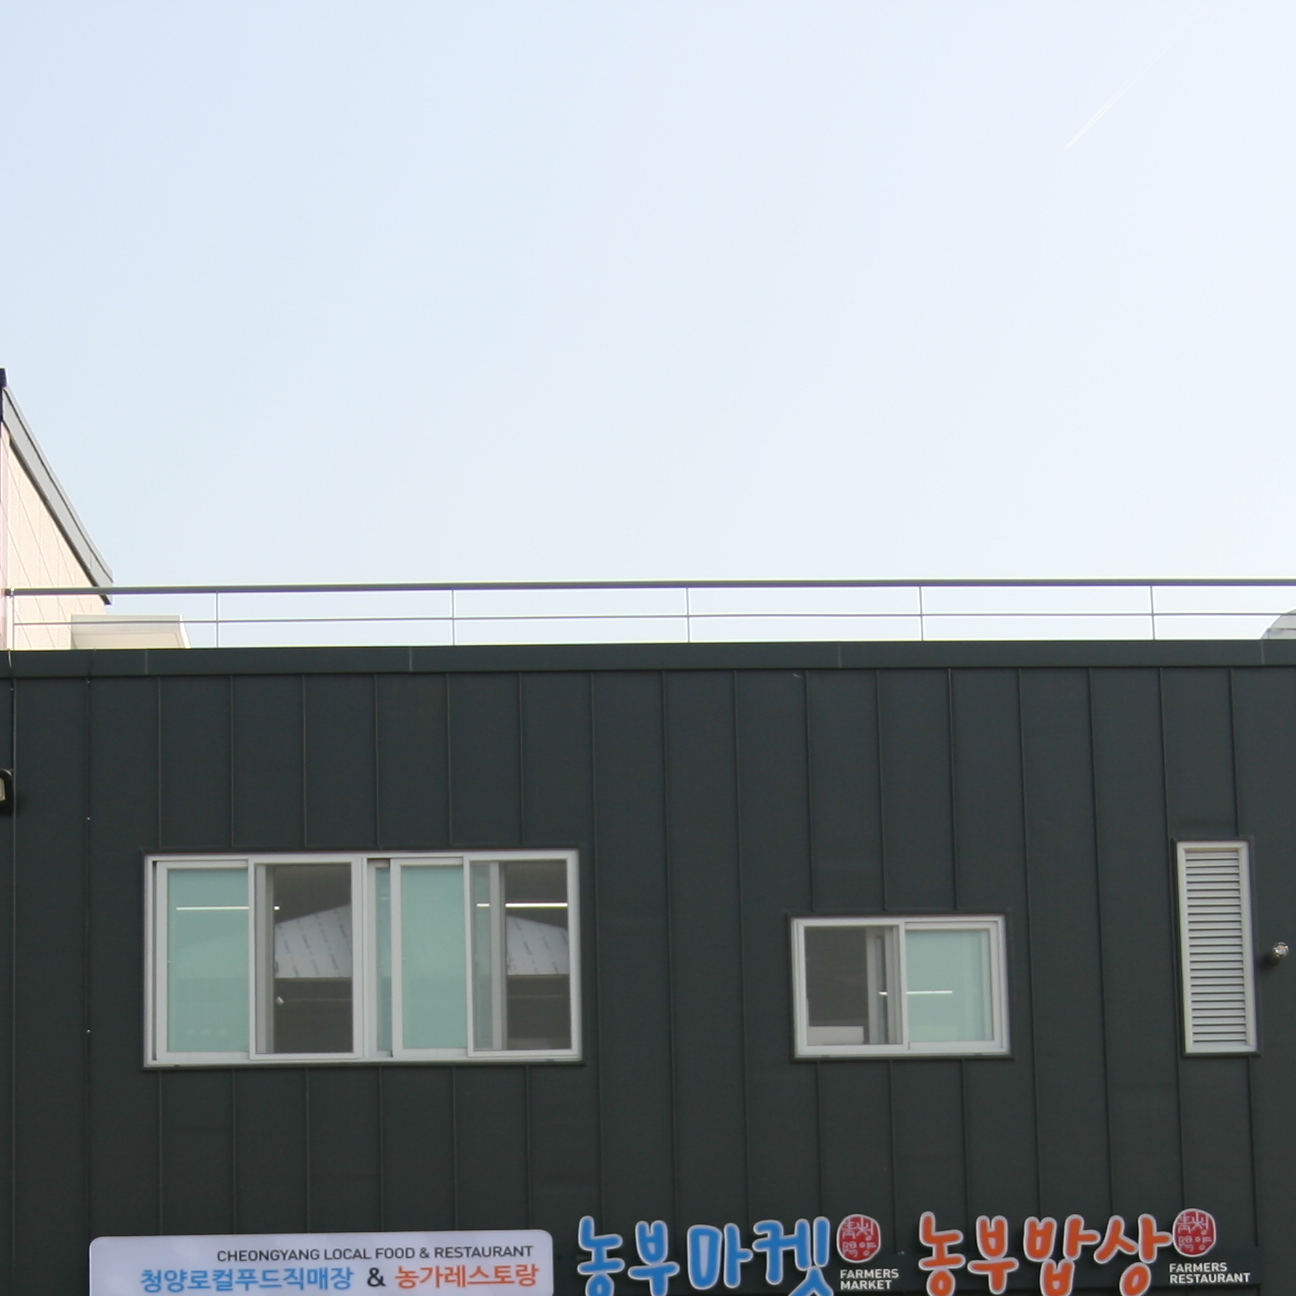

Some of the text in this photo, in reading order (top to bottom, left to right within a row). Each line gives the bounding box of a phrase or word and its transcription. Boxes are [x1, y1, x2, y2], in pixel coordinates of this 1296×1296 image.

[217, 1245, 533, 1262] CHEONGYANG LOCAL FOOD & RESTAURANT
[1169, 1262, 1227, 1273] FARMERS
[140, 1263, 539, 1293] 청양로컬푸드직매장 & 농가레스토랑
[840, 1269, 899, 1279] FARMERS
[1170, 1273, 1250, 1284] RESTAURANT
[840, 1280, 892, 1290] MARKET
